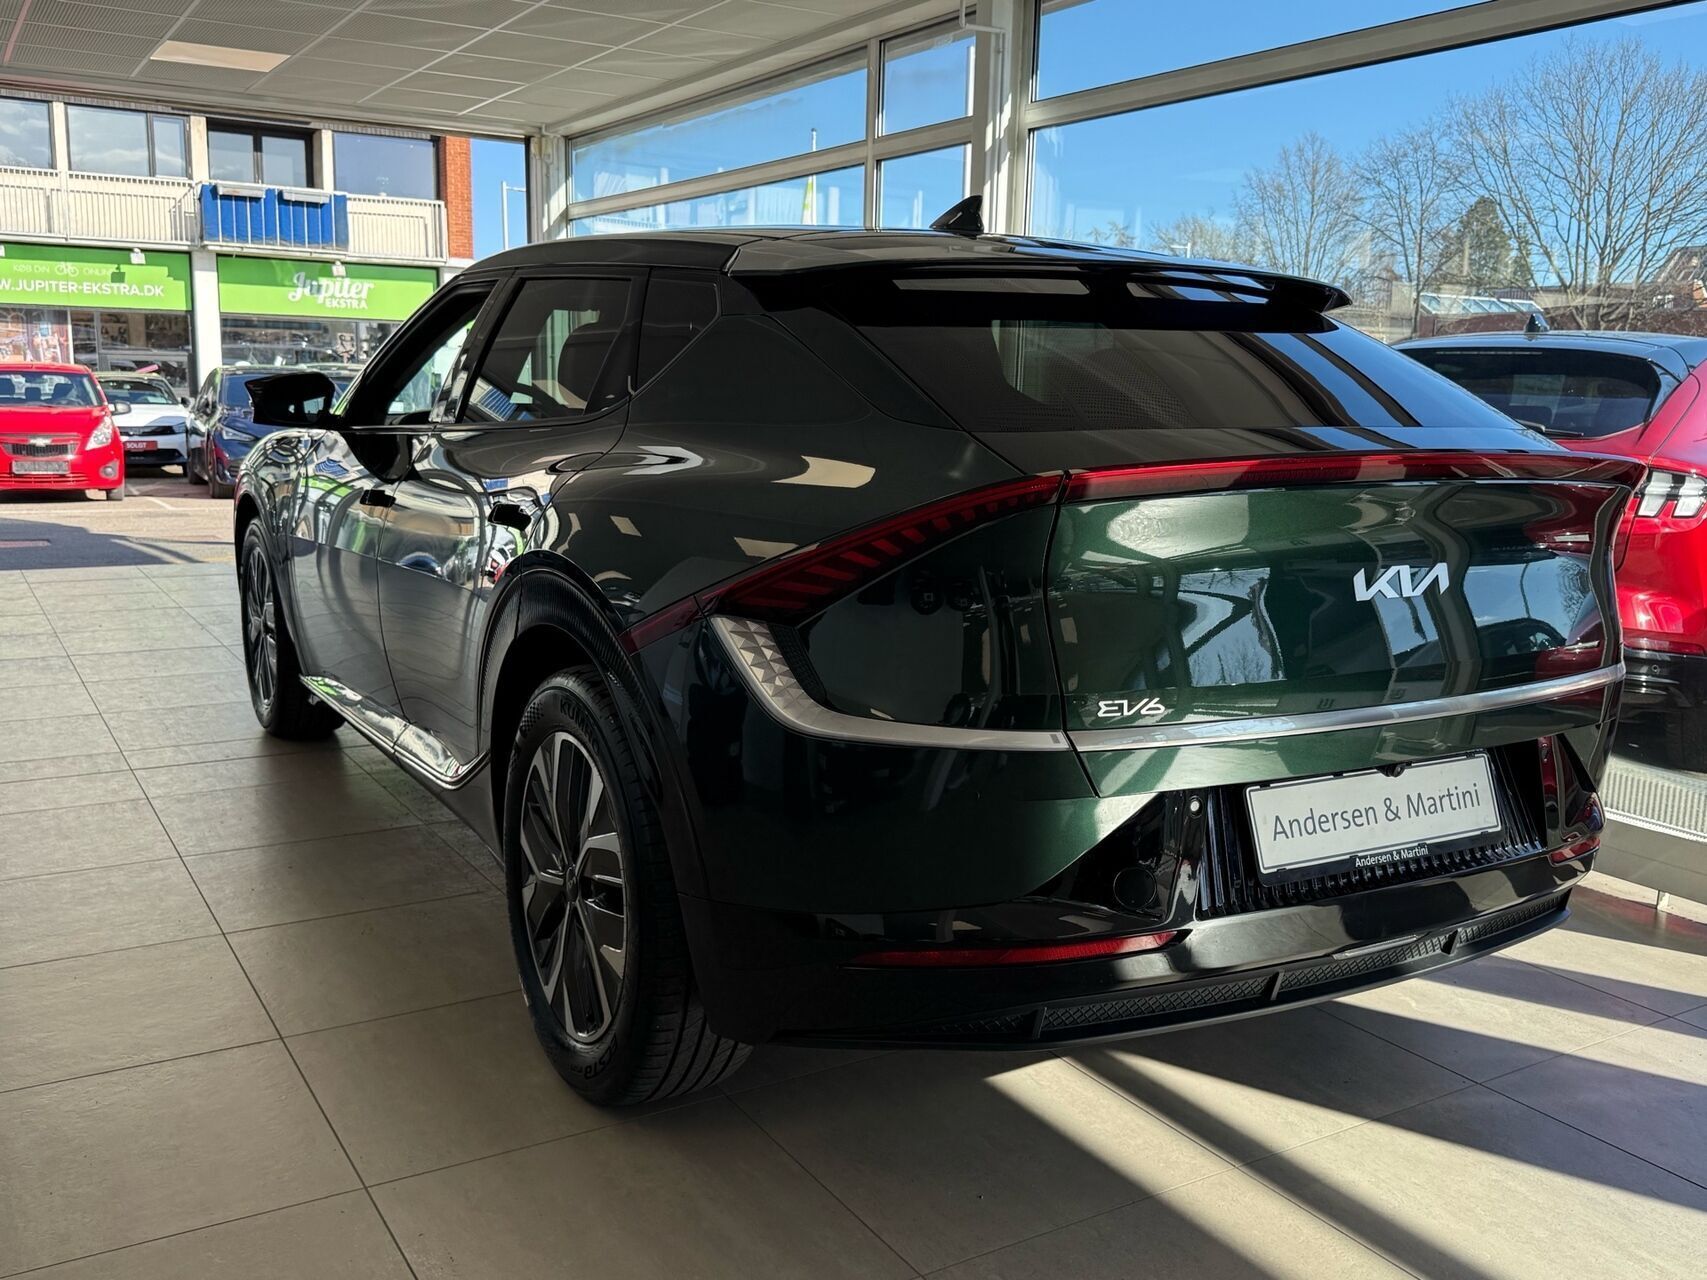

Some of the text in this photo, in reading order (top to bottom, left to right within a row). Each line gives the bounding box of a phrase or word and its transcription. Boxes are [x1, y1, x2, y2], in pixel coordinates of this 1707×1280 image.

[13, 264, 32, 273] KØB
[34, 265, 50, 273] DIN
[288, 272, 375, 304] Jupiter
[325, 297, 368, 309] EKSTRA
[1353, 562, 1450, 602] KIA
[1097, 697, 1166, 718] EV6
[1272, 783, 1481, 842] Andersen & Martini
[1355, 845, 1428, 868] Andersen & Martini
